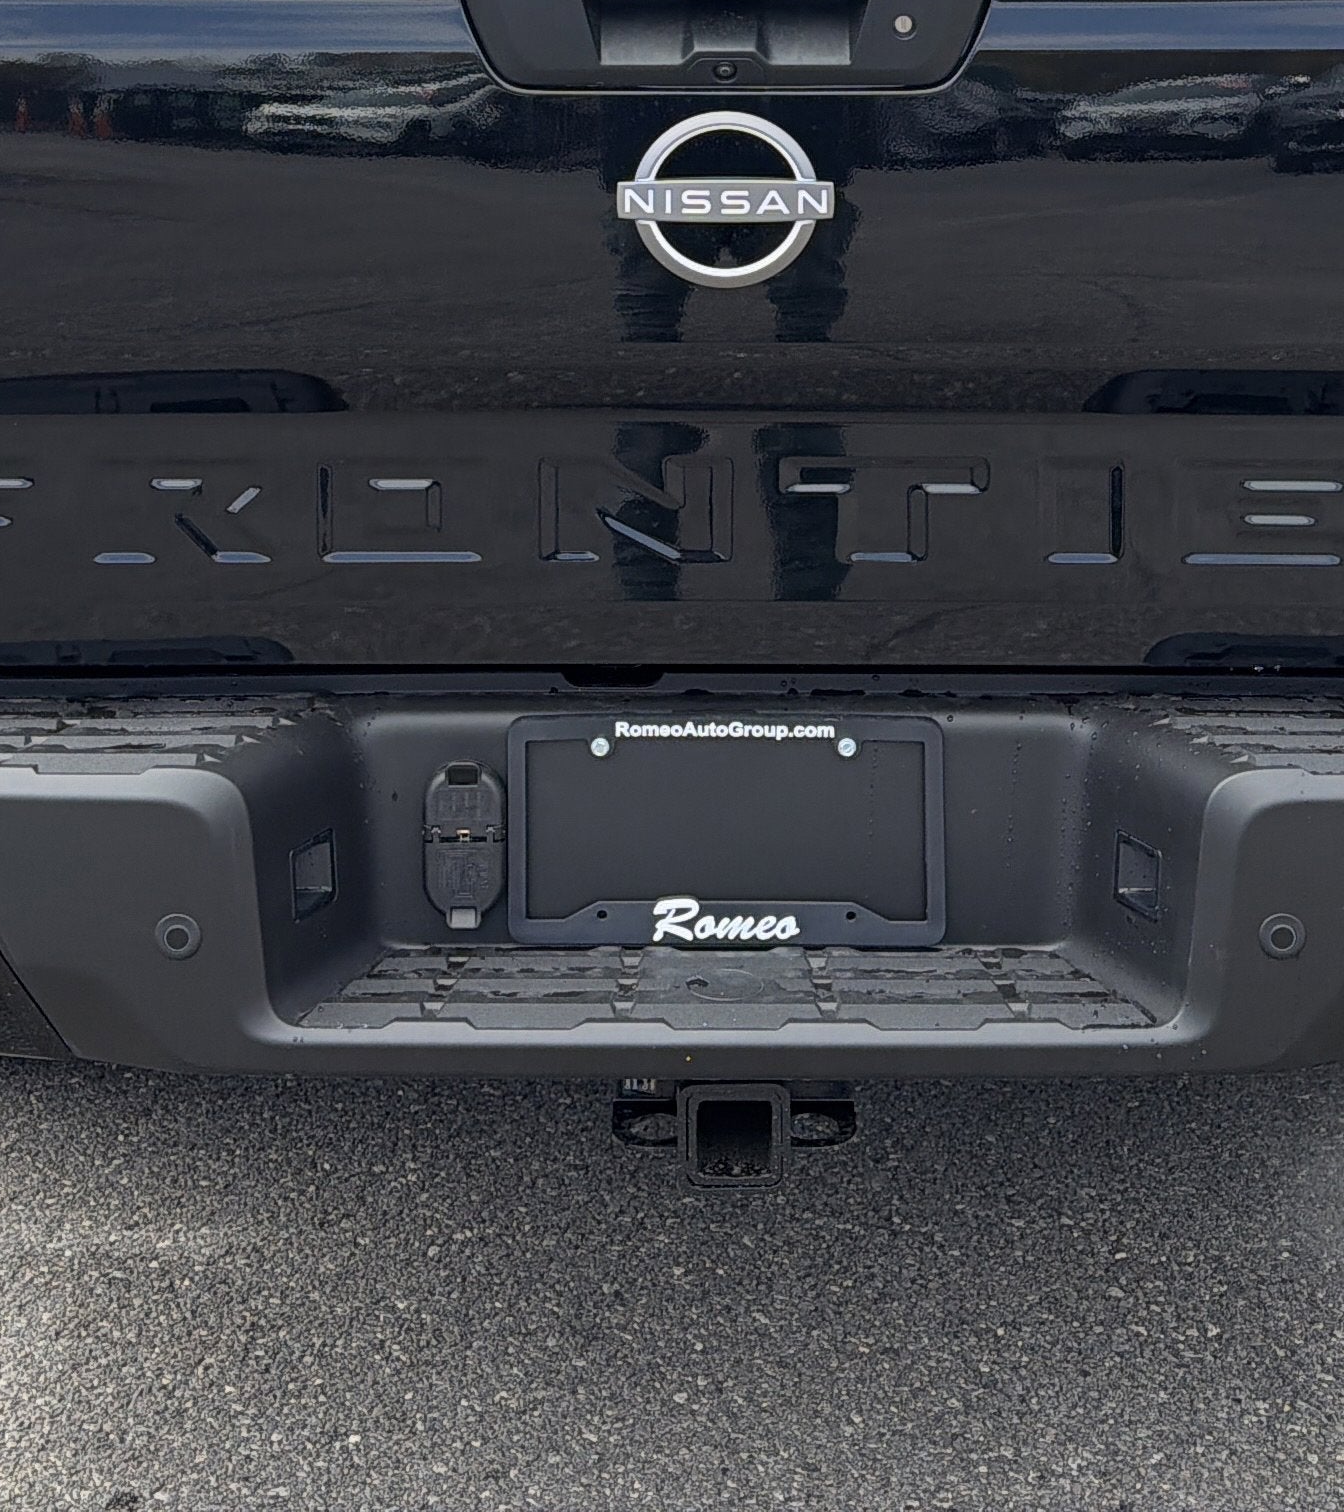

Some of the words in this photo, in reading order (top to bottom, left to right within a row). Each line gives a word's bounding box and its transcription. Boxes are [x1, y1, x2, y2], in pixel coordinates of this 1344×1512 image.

[624, 188, 828, 215] NISSAN
[614, 721, 835, 741] RomeoAutoGroup.com
[652, 897, 801, 942] Romeo
